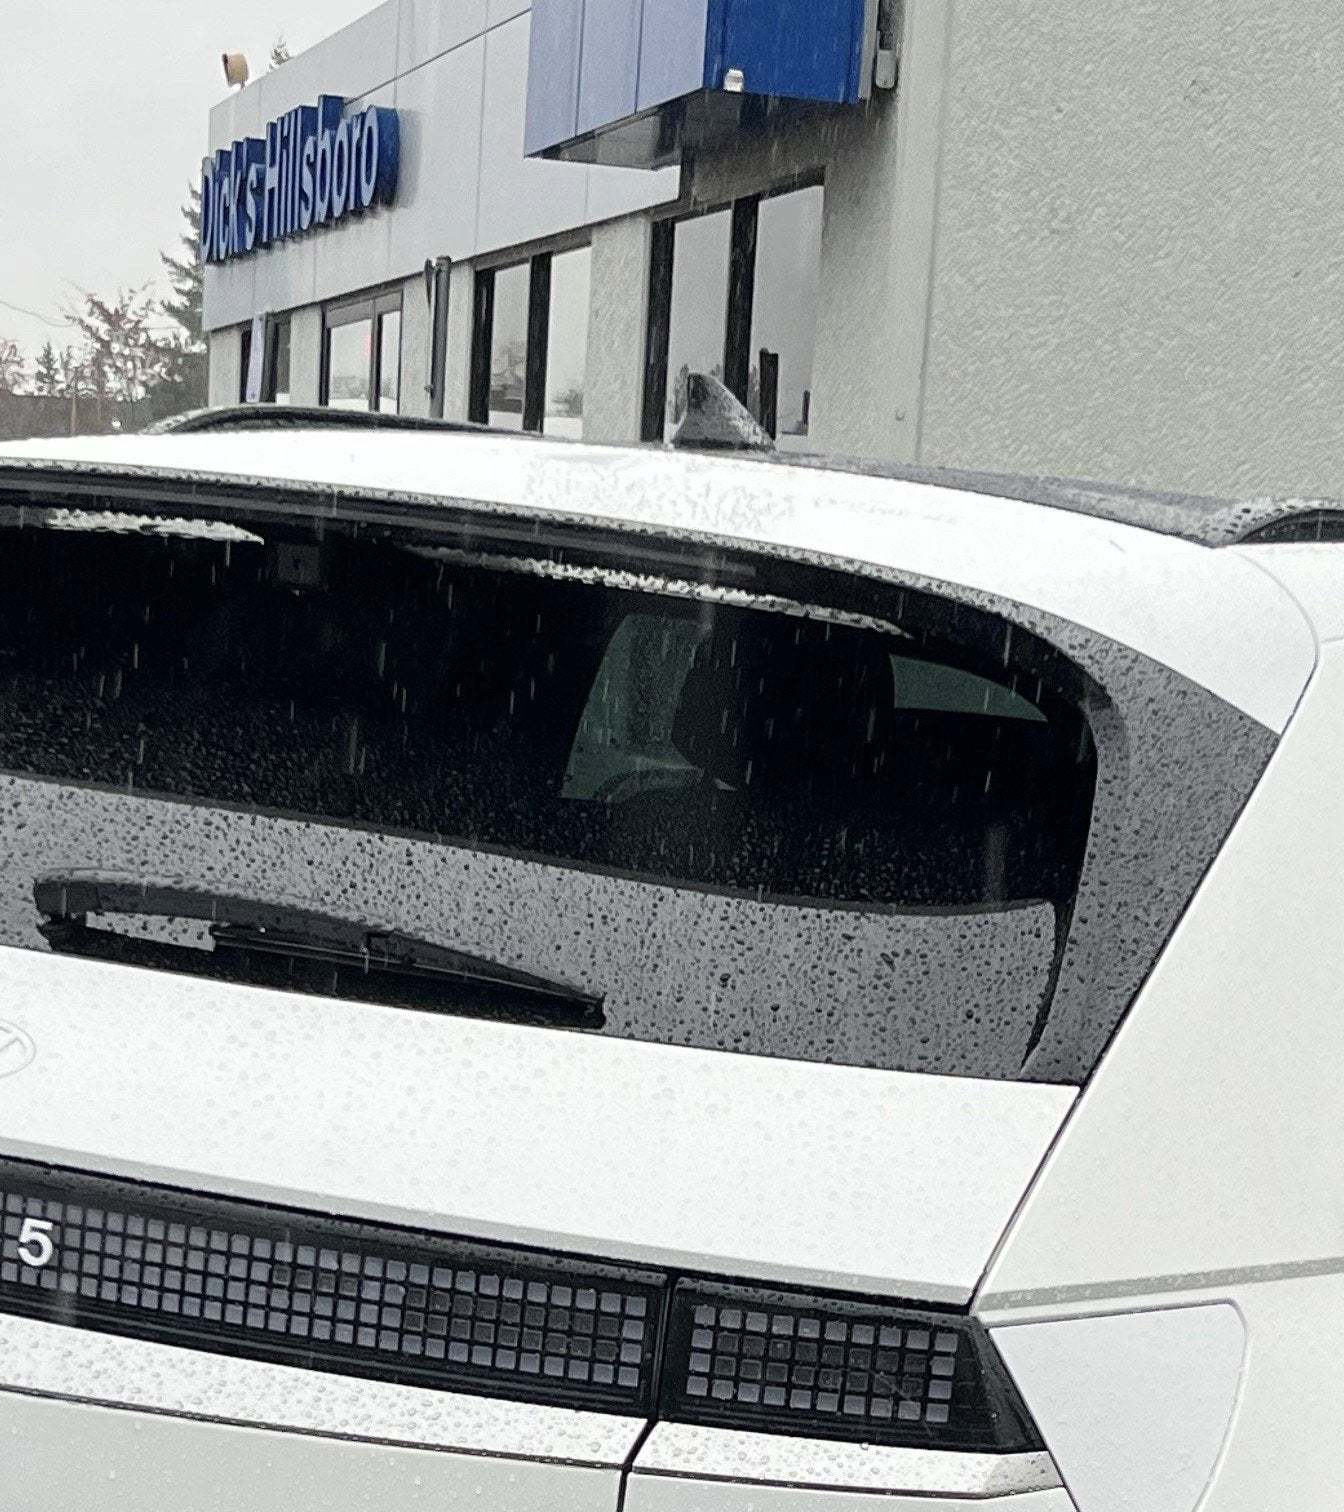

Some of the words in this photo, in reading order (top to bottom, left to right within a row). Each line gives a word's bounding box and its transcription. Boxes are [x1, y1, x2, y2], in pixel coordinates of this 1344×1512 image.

[200, 138, 257, 262] Dick's
[261, 94, 379, 243] Hillsboro
[17, 1217, 54, 1267] 5
